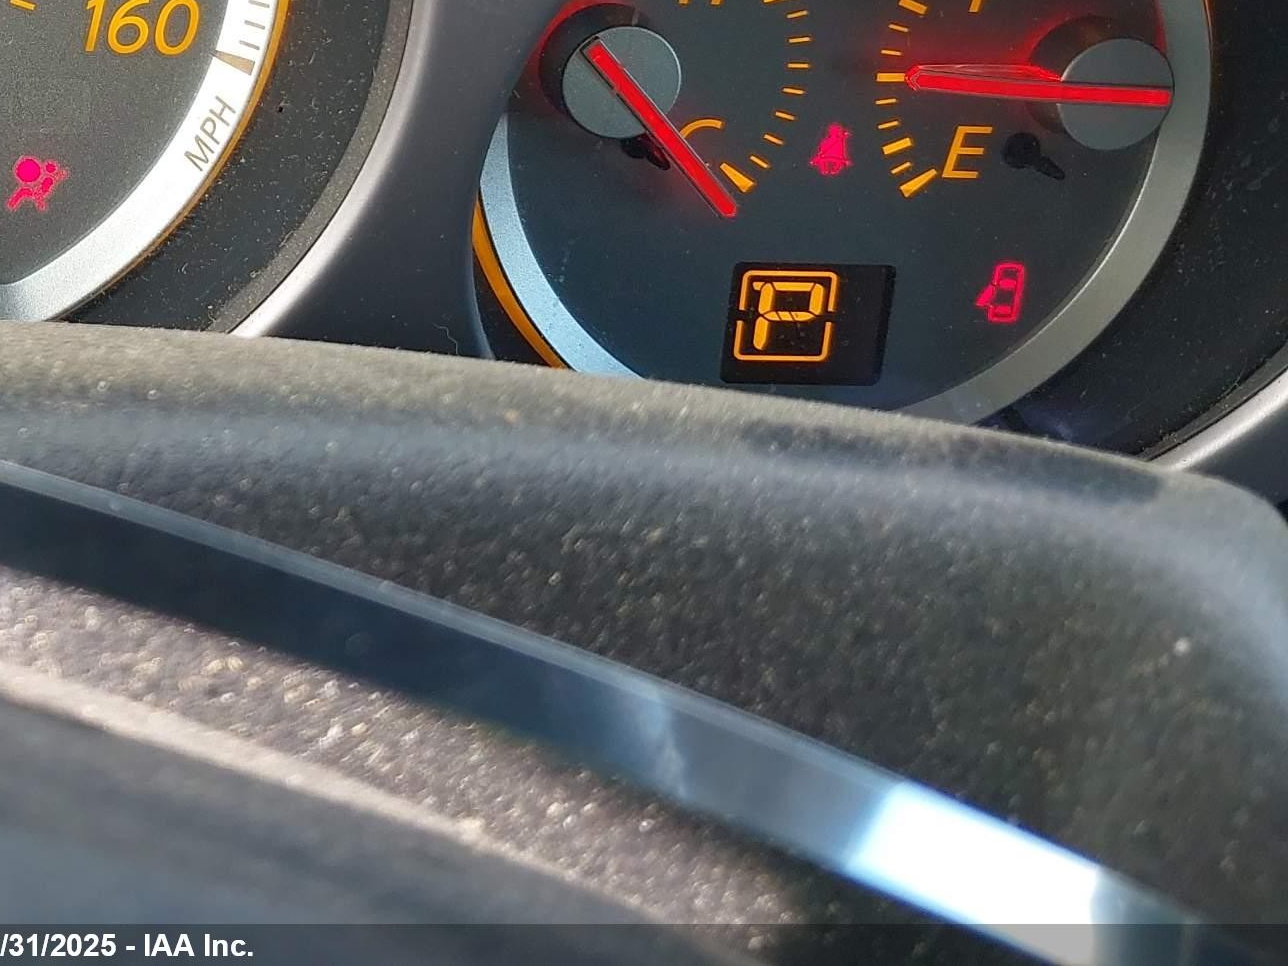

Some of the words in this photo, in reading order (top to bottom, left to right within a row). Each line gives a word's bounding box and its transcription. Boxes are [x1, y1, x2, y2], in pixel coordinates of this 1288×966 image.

[184, 95, 237, 172] MPH
[941, 125, 993, 179] E
[752, 281, 825, 351] P
